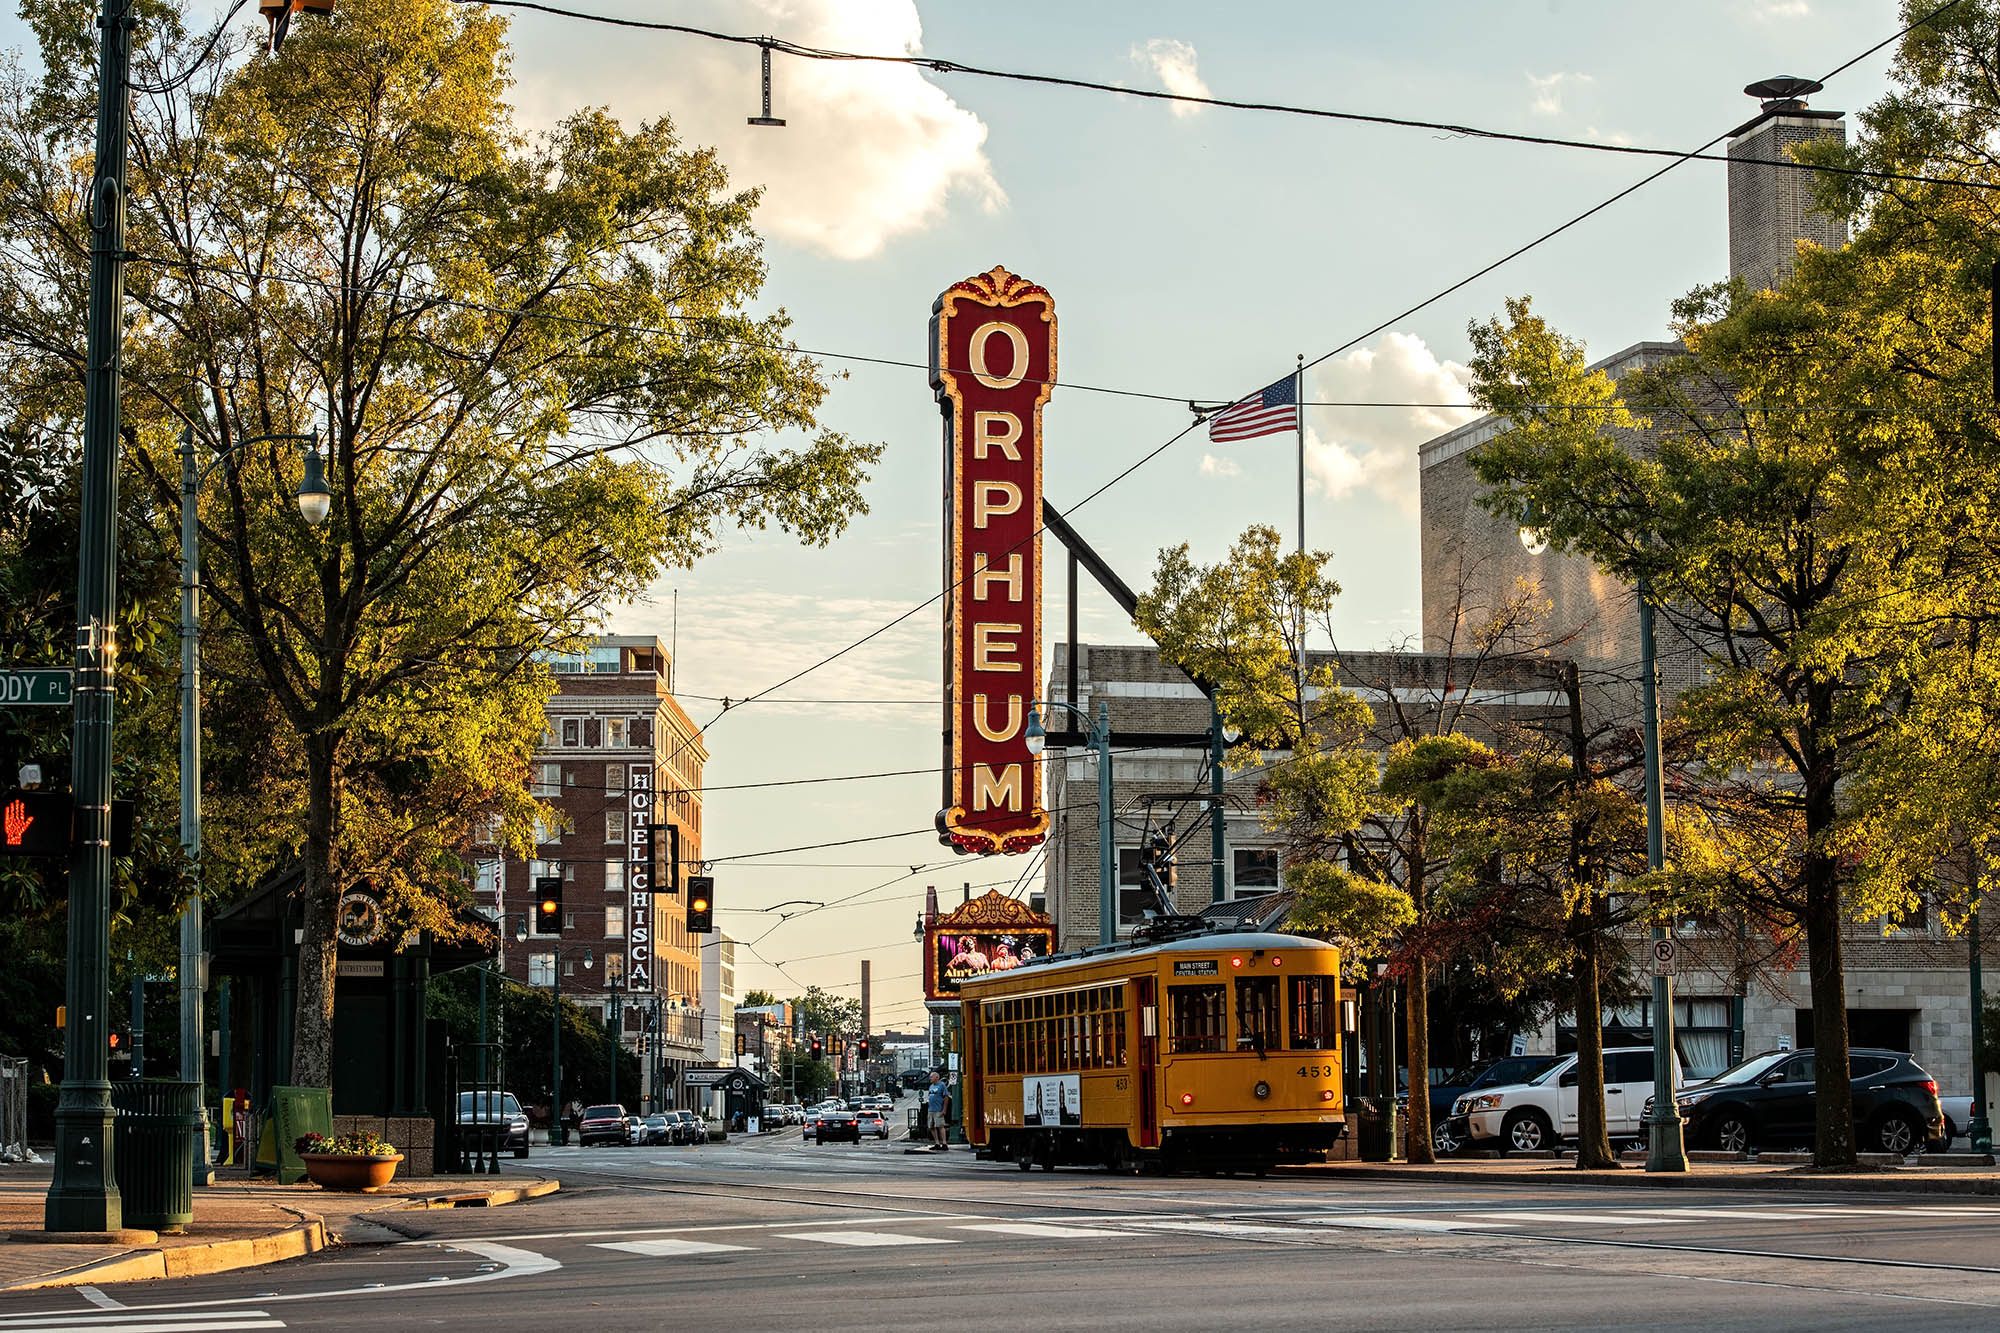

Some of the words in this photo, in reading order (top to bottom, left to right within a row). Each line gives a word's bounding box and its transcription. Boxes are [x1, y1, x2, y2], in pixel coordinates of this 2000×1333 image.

[968, 320, 1030, 814] ORPHEUM
[49, 681, 66, 695] PL
[632, 774, 649, 862] HOTEL
[631, 873, 649, 980] CHISCA
[1192, 962, 1210, 970] STREET
[944, 968, 973, 978] Ain't
[1296, 1065, 1332, 1078] 453
[1115, 1078, 1128, 1090] 453
